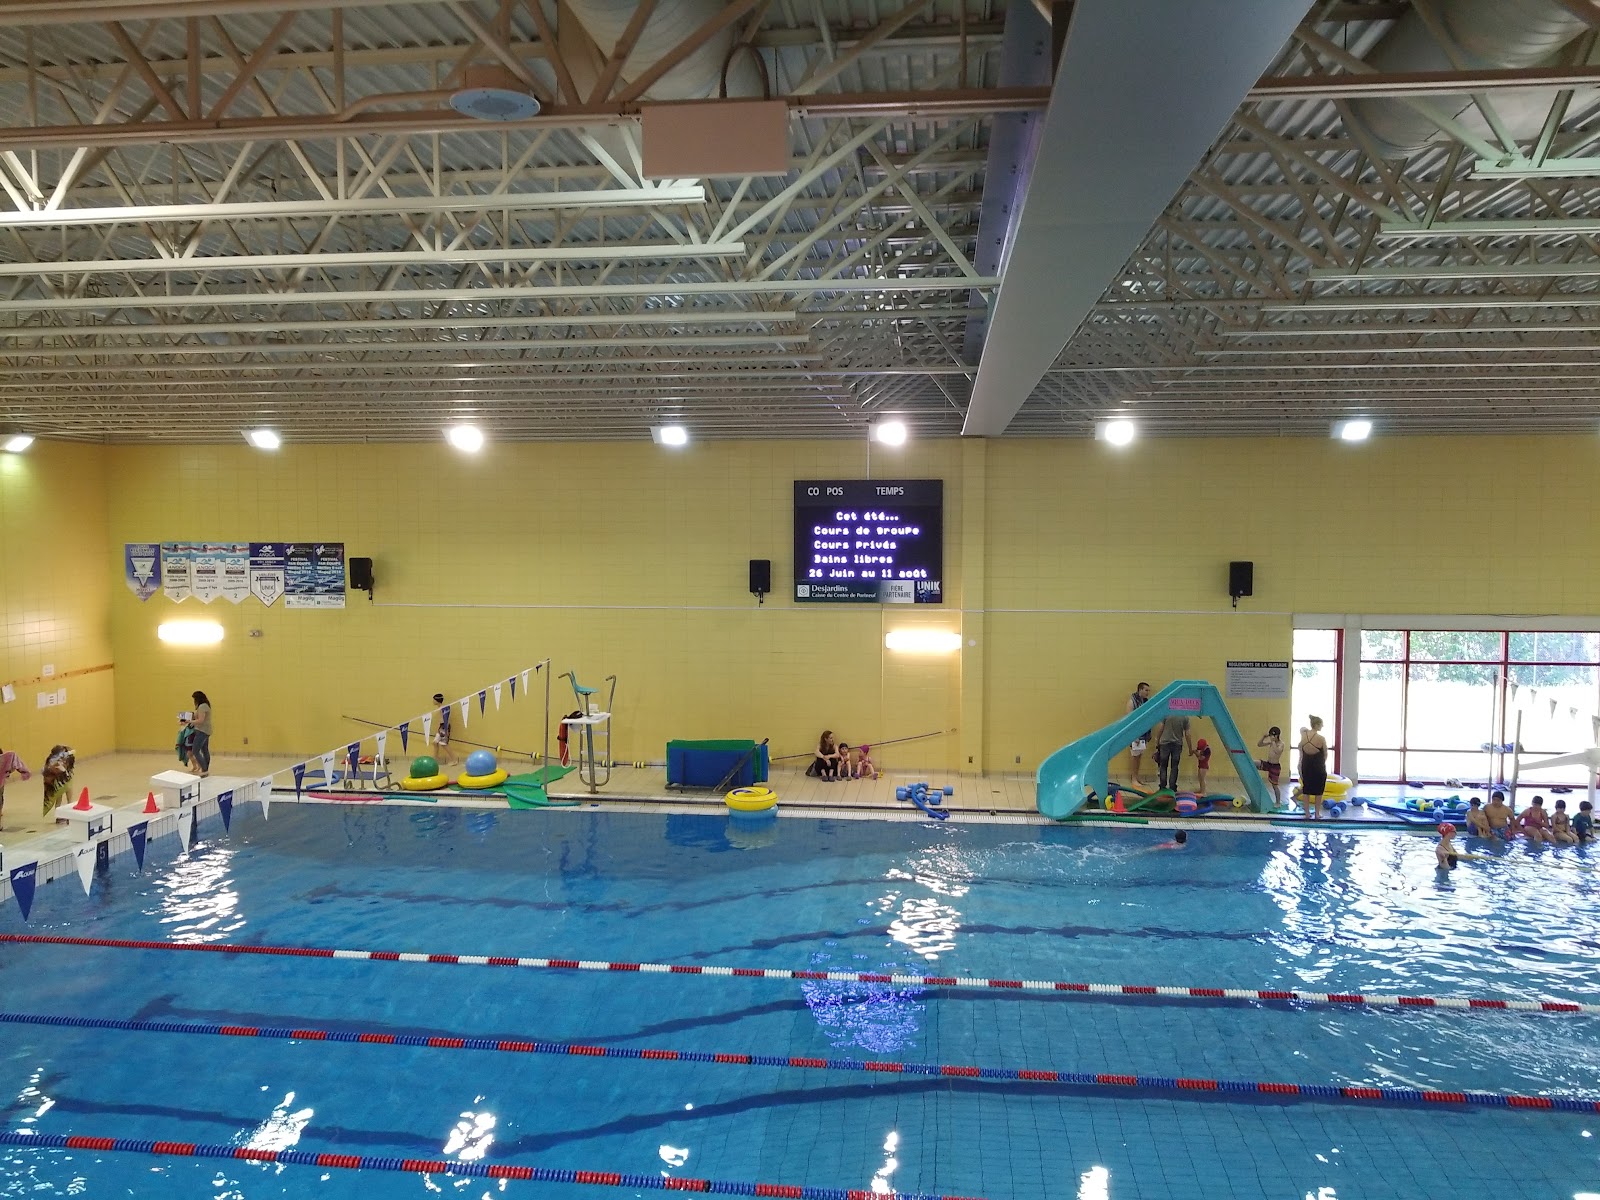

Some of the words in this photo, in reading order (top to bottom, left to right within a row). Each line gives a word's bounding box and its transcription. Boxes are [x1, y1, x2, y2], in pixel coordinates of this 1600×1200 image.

[807, 487, 820, 496] CO
[826, 487, 844, 496] POS
[875, 486, 904, 495] TEMPS
[836, 511, 857, 521] Cet
[814, 526, 849, 535] Cours
[855, 526, 870, 535] de
[814, 540, 849, 549] Cours
[814, 554, 848, 563] Bains
[854, 554, 893, 563] libres
[809, 568, 823, 578] 26
[861, 569, 876, 578] au
[881, 568, 892, 578] 11
[898, 568, 928, 578] août
[811, 584, 848, 593] Desjardins
[917, 581, 940, 590] UNIK
[99, 846, 106, 860] 5
